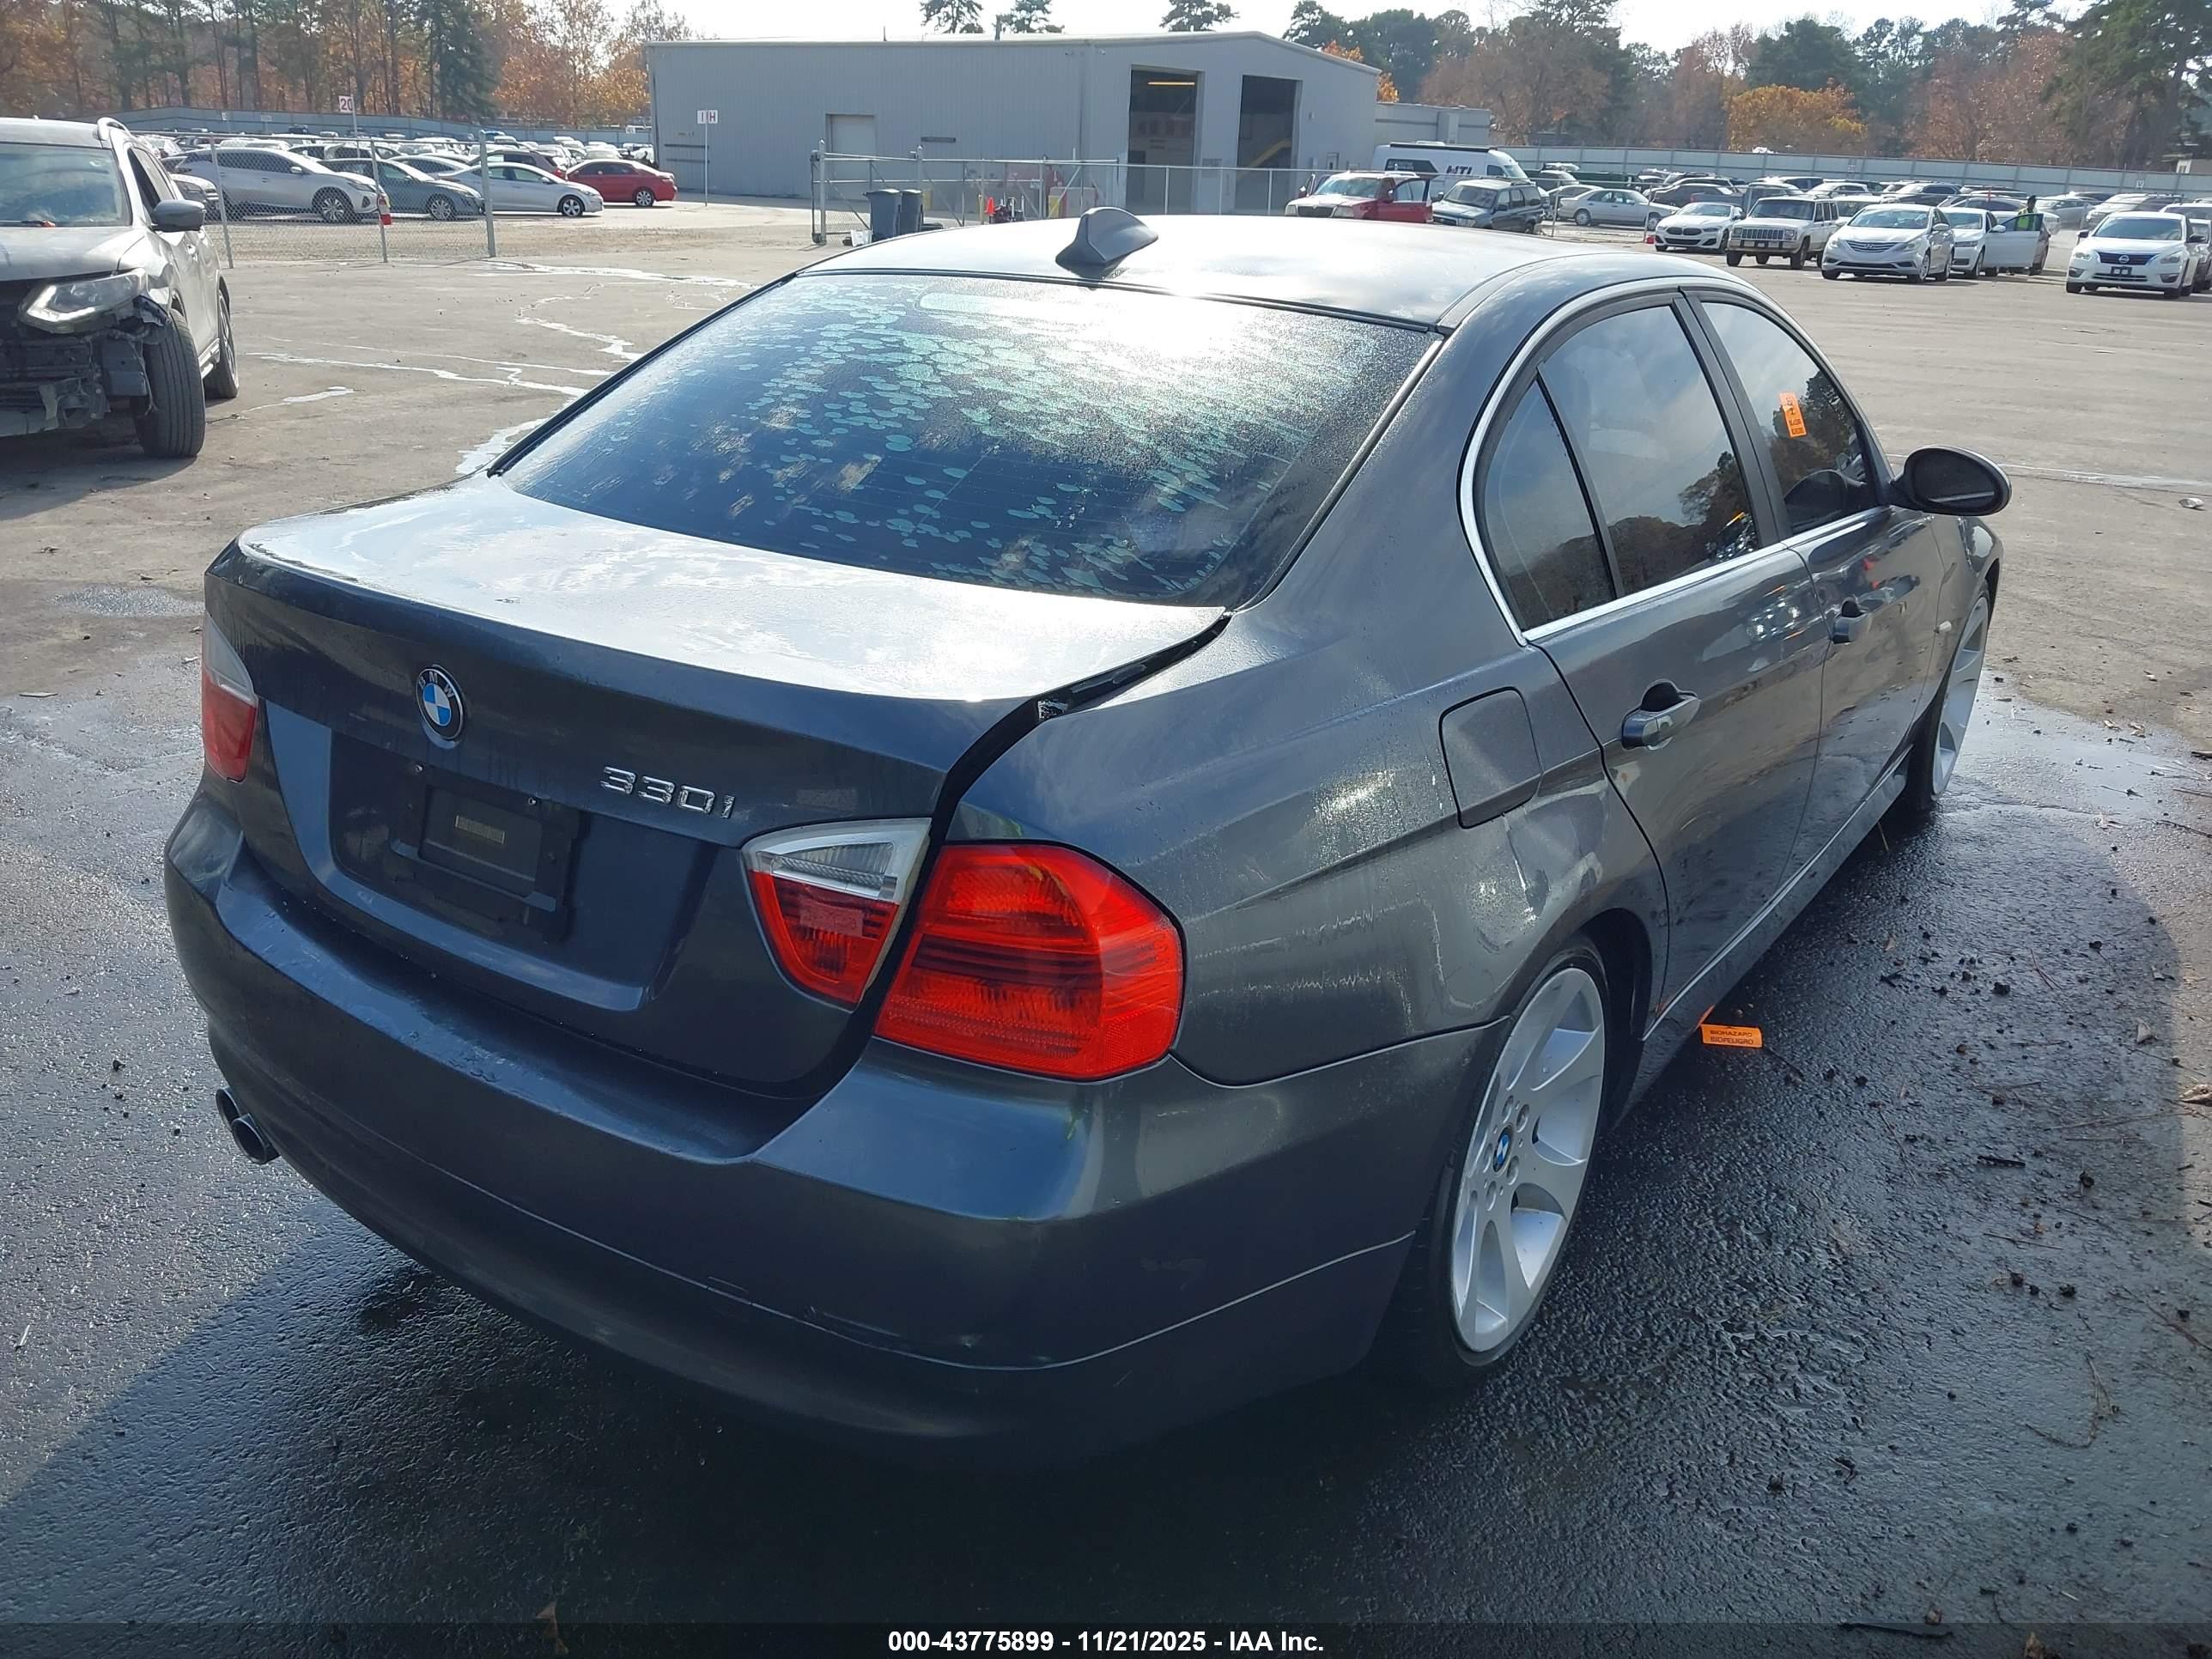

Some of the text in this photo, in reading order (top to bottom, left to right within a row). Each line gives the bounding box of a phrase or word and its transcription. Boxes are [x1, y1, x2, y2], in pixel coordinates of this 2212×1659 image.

[341, 98, 352, 111] 20
[419, 672, 454, 697] BMW
[600, 766, 735, 818] 330i
